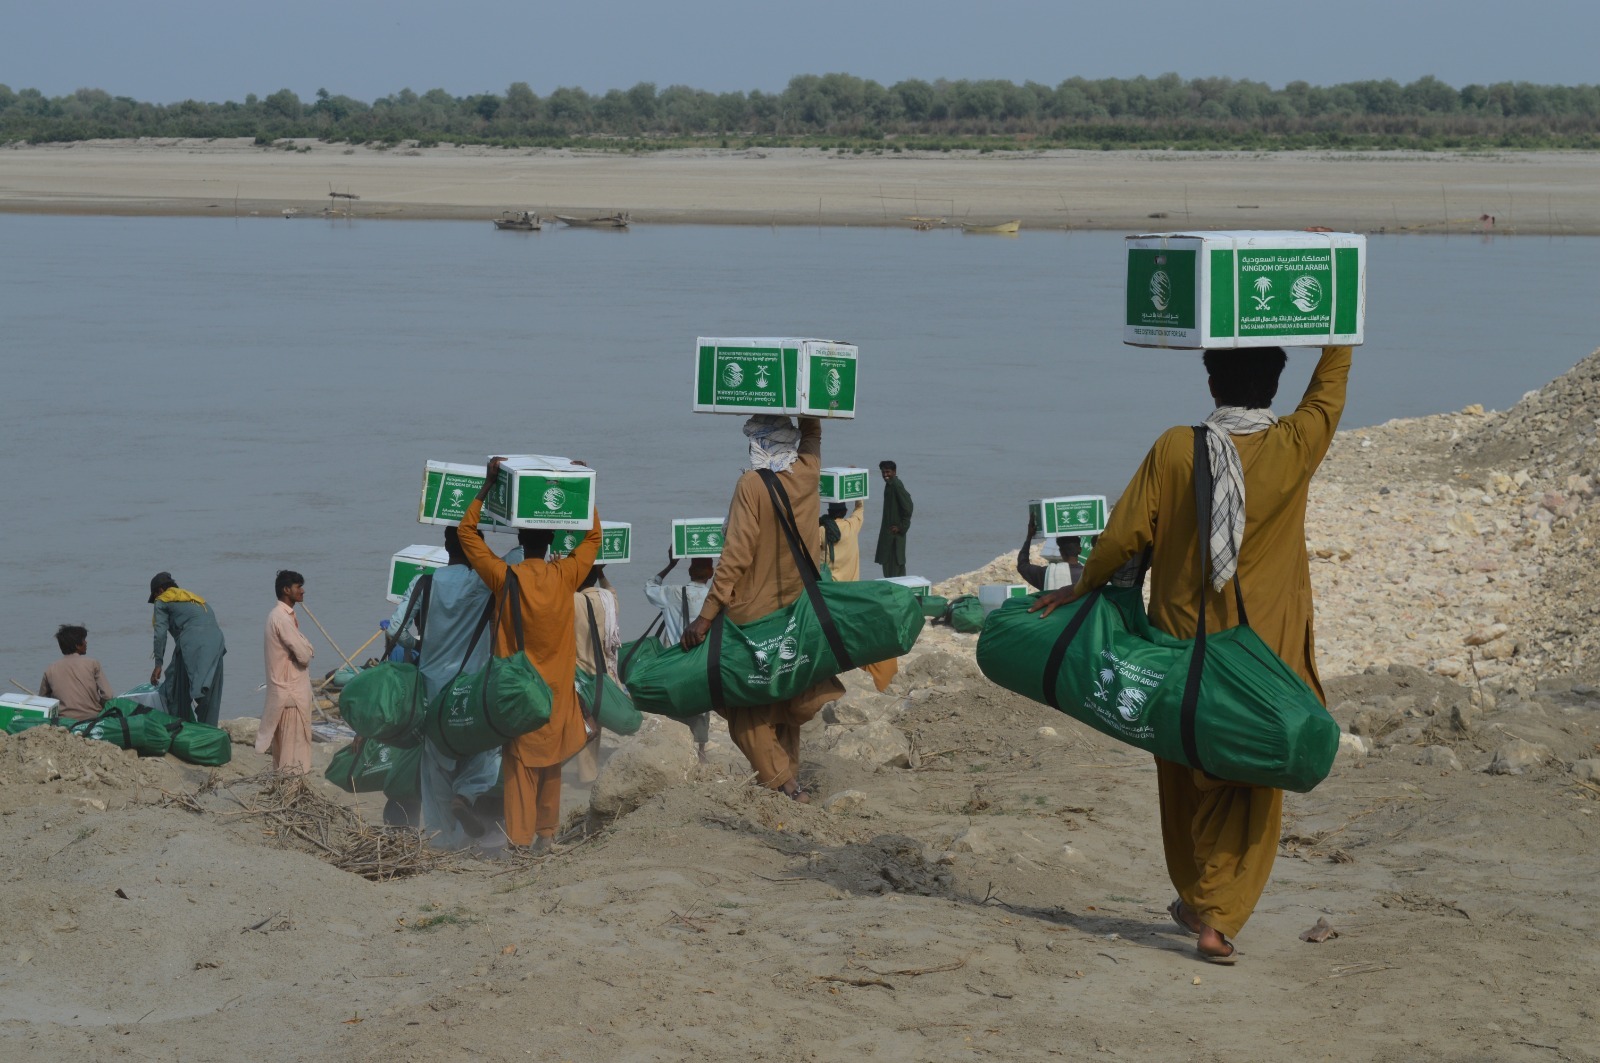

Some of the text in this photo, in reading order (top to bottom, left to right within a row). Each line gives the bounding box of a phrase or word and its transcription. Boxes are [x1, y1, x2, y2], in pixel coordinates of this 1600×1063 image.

[1242, 256, 1276, 265] السعودية
[1277, 255, 1300, 264] العربية
[1242, 264, 1274, 272] KINGDOM
[1304, 263, 1330, 271] ARABIA
[1118, 667, 1141, 682] SAUDI
[1141, 668, 1165, 680] لمملكة
